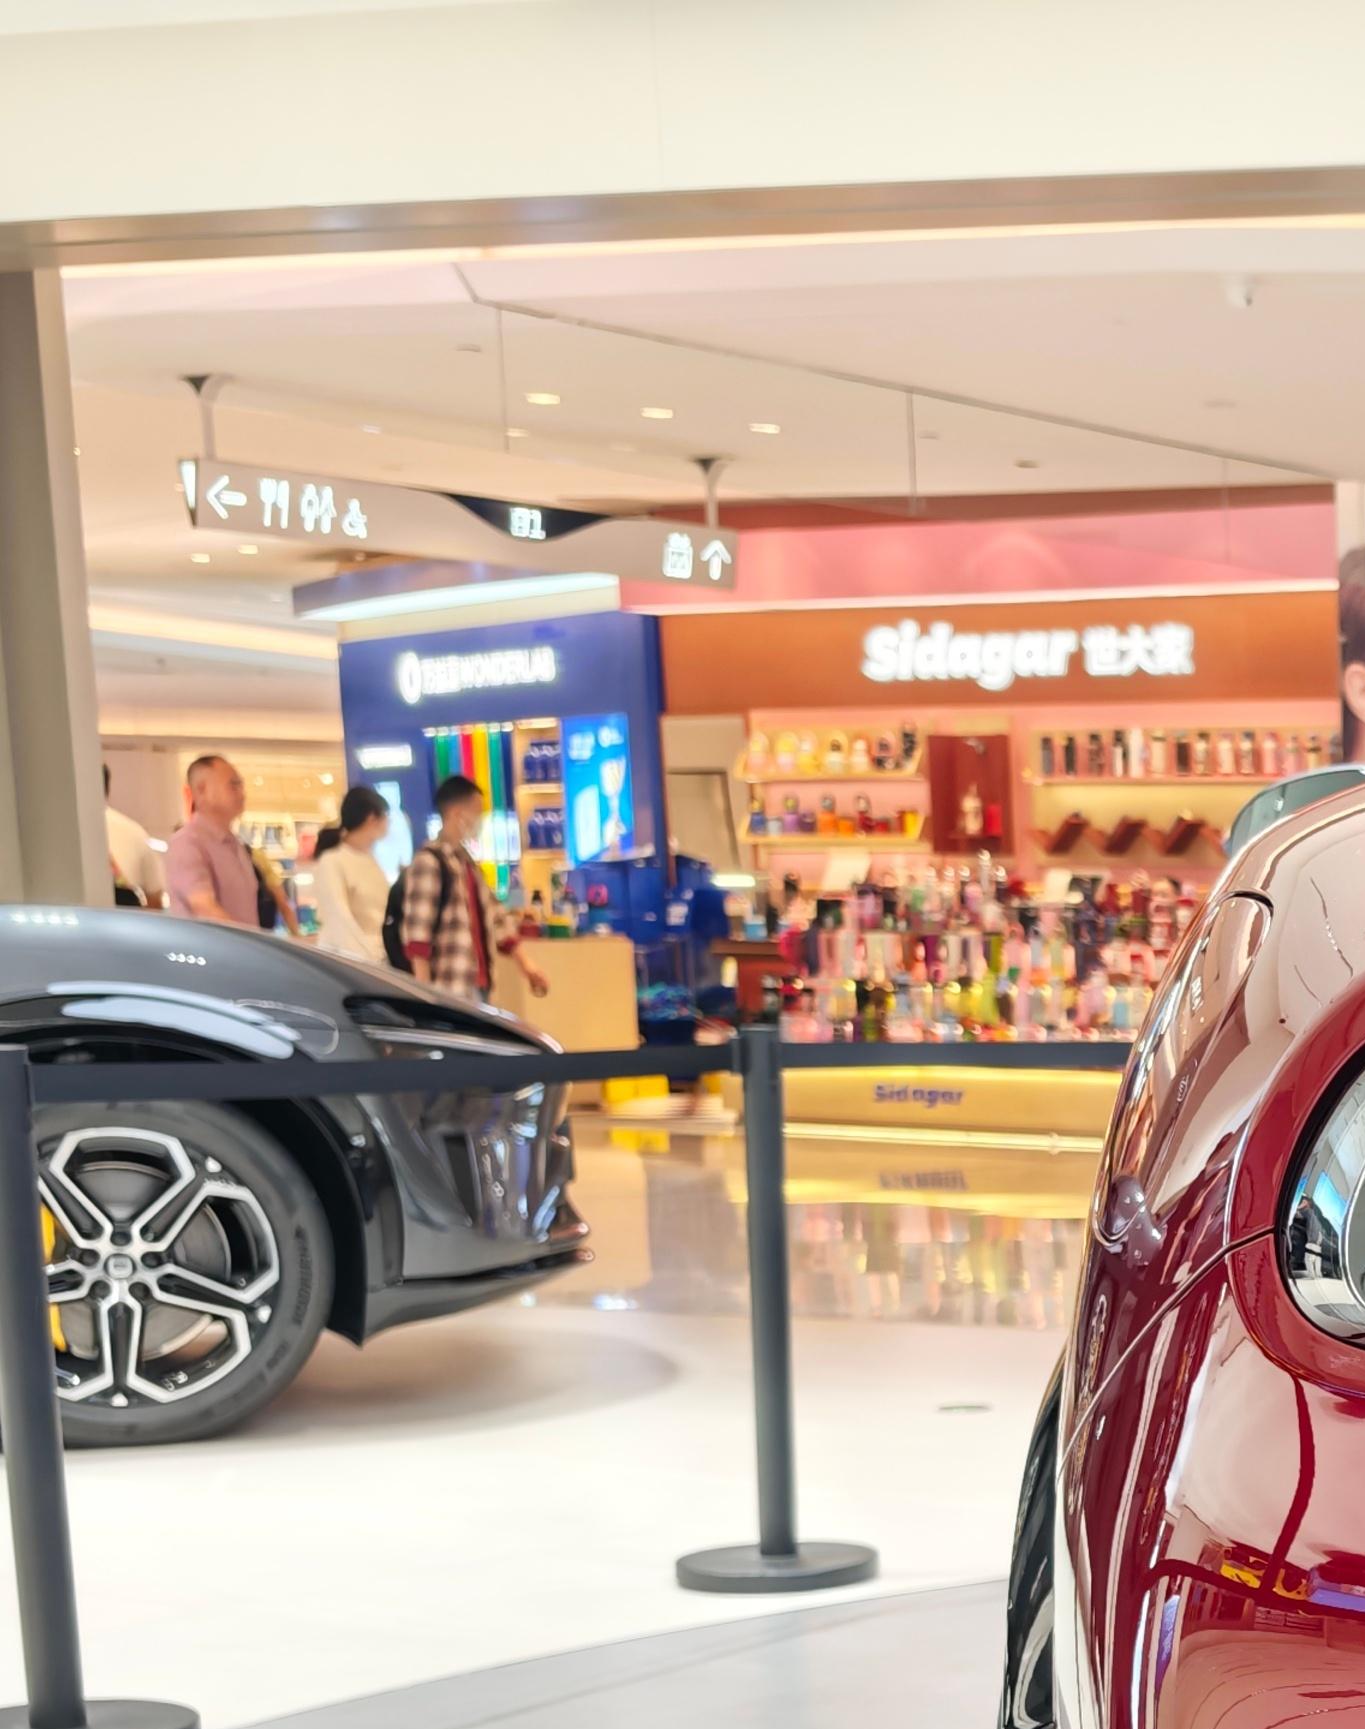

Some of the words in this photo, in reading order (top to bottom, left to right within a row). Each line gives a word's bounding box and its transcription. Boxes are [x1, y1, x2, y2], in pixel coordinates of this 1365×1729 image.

[510, 507, 546, 540] B1
[861, 619, 1079, 691] Sidagar
[874, 1084, 963, 1109] Sidagar
